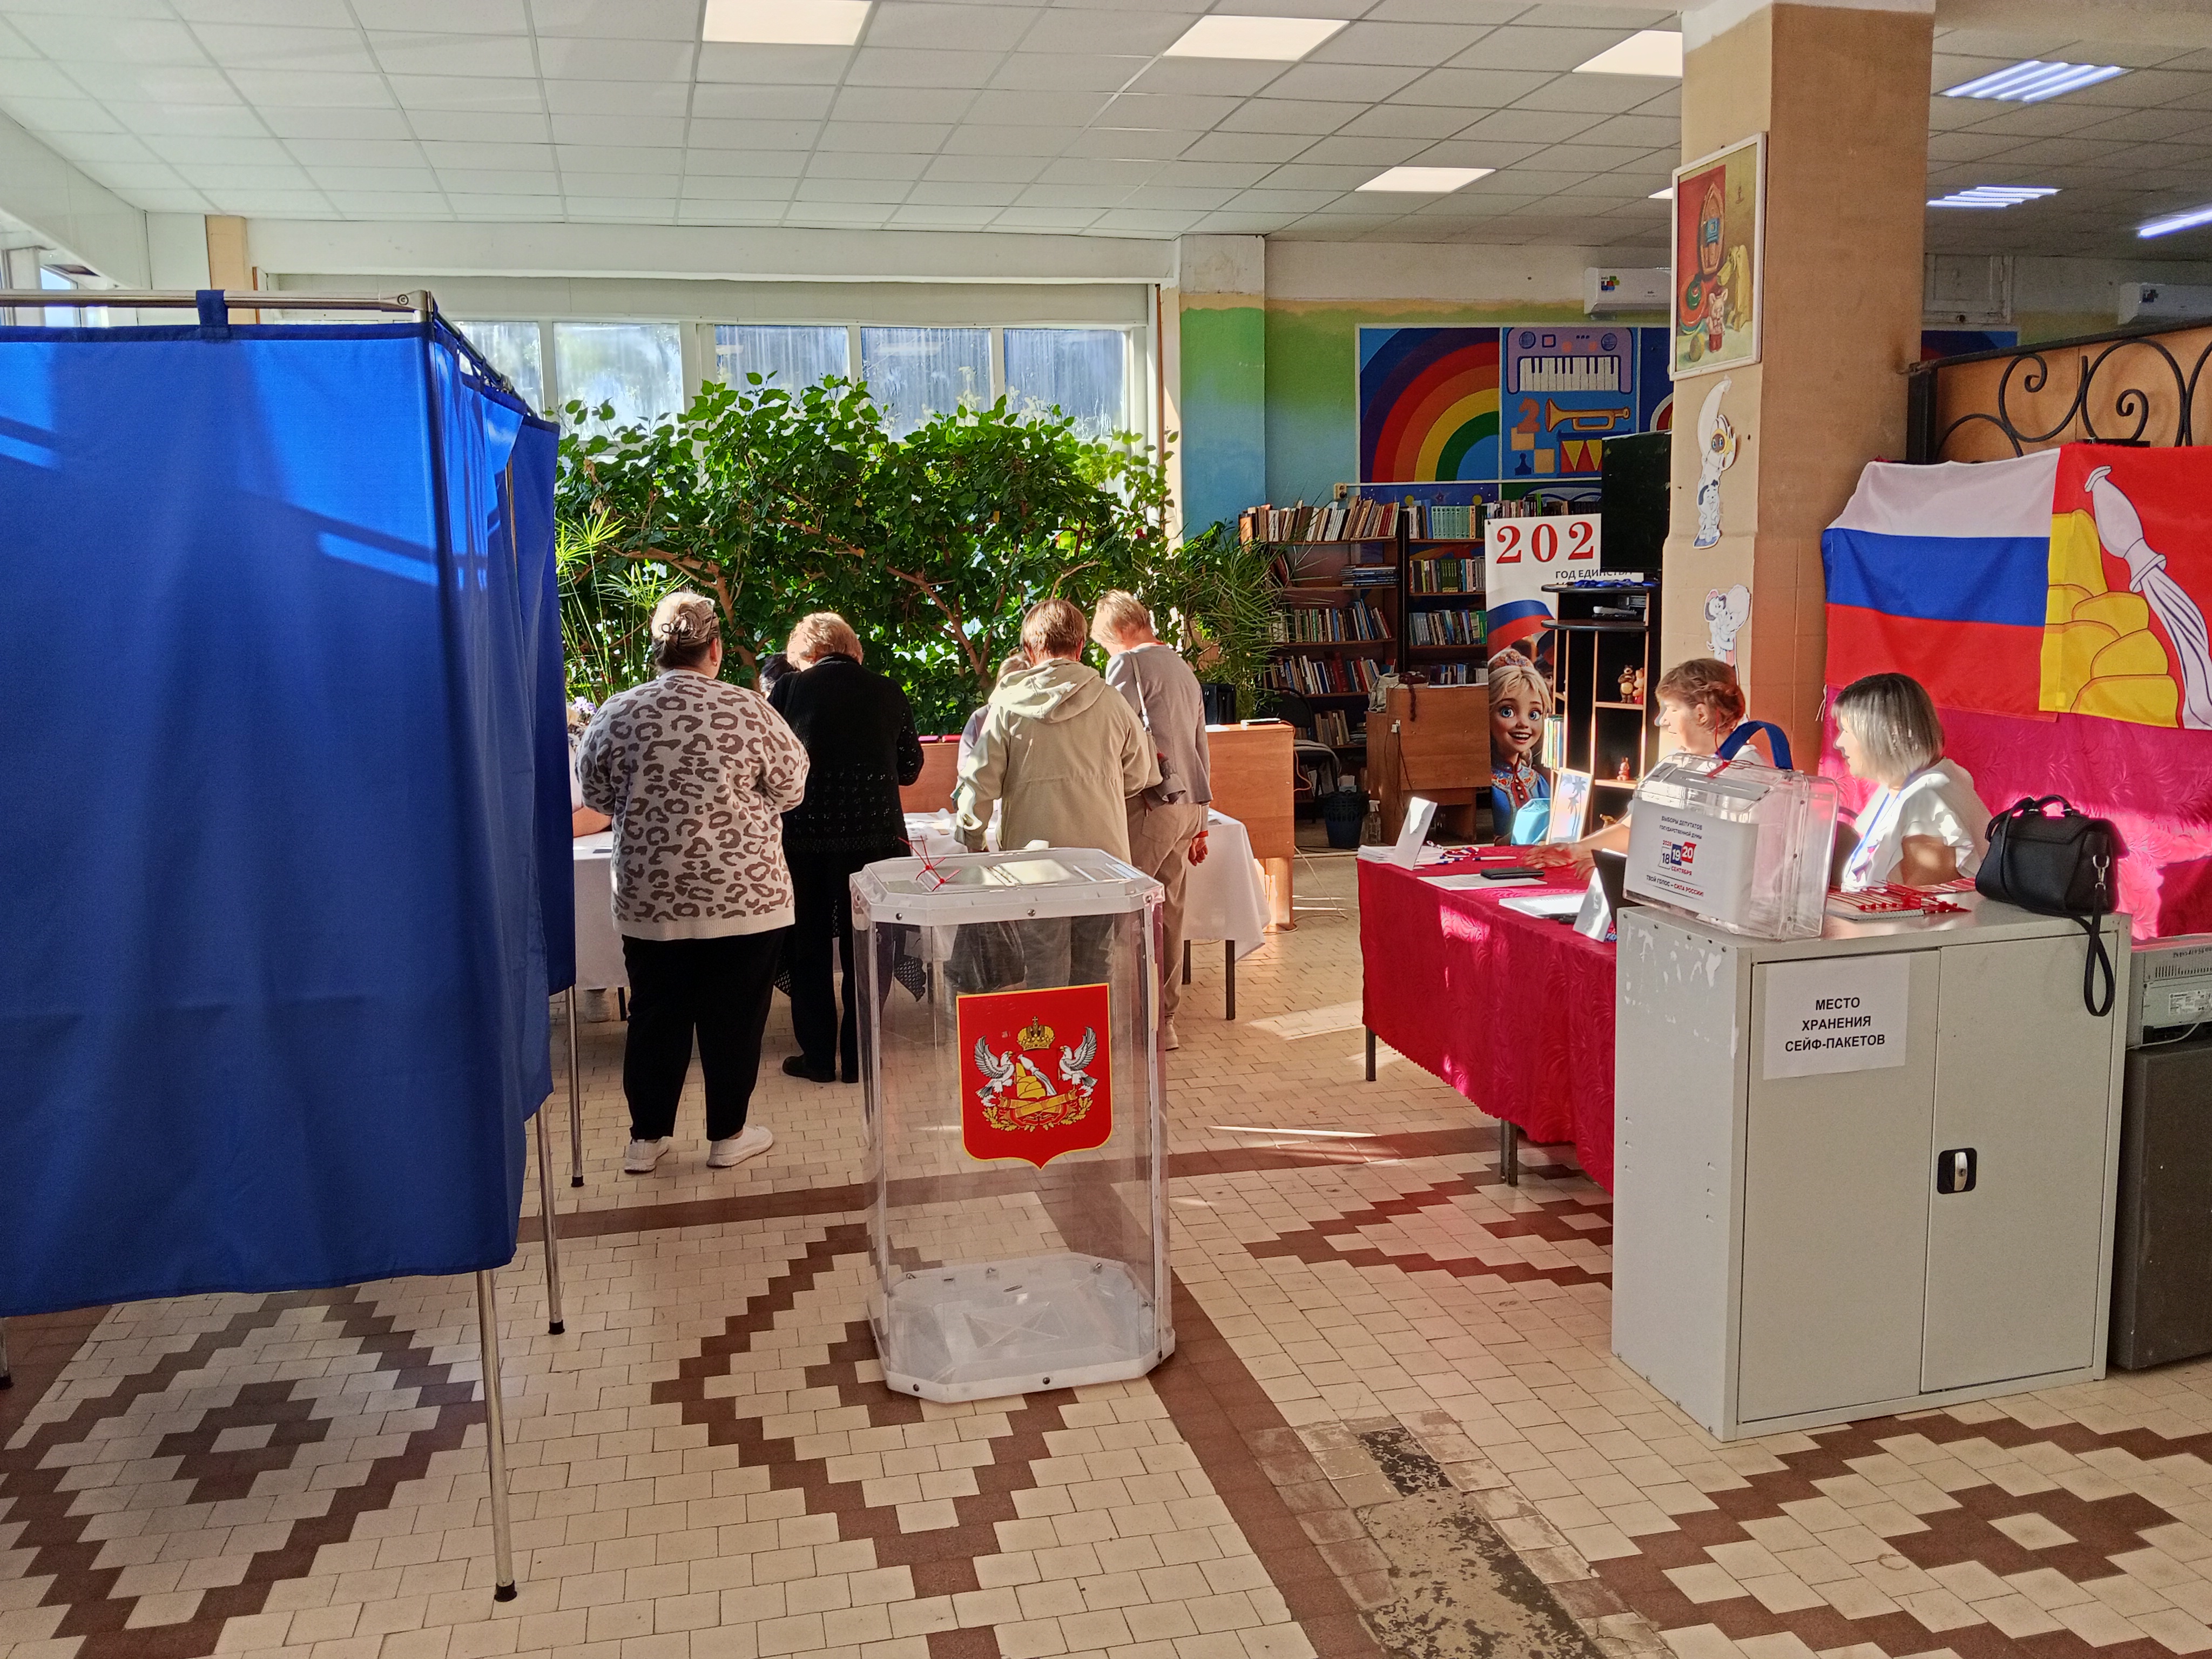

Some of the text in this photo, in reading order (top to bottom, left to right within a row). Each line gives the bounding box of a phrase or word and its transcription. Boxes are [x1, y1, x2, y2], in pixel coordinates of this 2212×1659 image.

[1496, 521, 1594, 564] 202
[1555, 570, 1576, 580] ГОД
[1661, 815, 1702, 830] ВЫБОРЫ ДЕПУТАТОВ
[1659, 825, 1691, 836] ГОСУДАРСТВЕННОЙ
[1662, 846, 1693, 864] 18 19 20
[1671, 866, 1692, 876] СЕНТЯБРЯ
[1657, 878, 1670, 887] ГОЛОС
[1815, 997, 1860, 1010] МЕСТО
[1802, 1016, 1872, 1031] ХРАНЕНИЯ
[1785, 1034, 1885, 1052] СЕЙФ-ПАКЕТОВ
